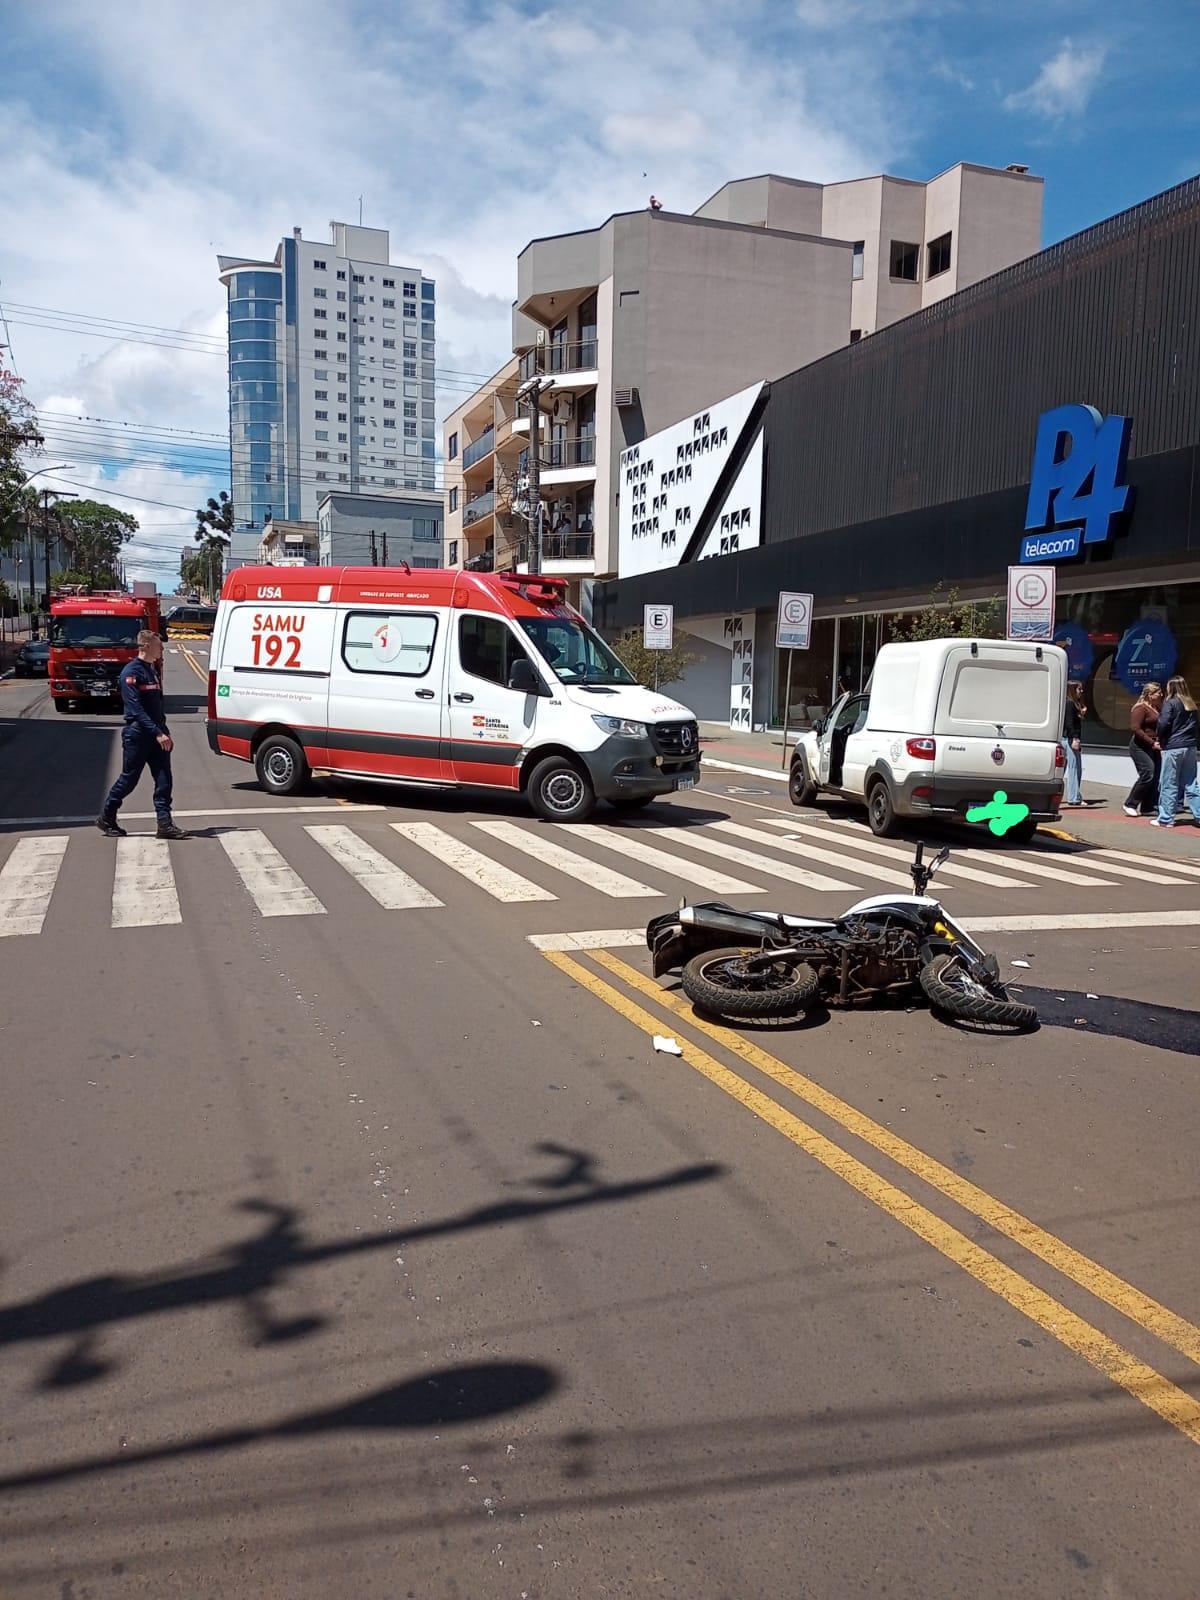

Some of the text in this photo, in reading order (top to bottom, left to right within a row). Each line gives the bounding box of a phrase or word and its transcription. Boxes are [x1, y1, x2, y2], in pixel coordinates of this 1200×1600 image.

[1025, 536, 1075, 557] telecom
[257, 586, 282, 599] USA
[1024, 580, 1039, 600] E
[654, 614, 663, 626] E
[790, 604, 800, 618] E
[252, 614, 305, 632] SAMU
[251, 634, 301, 668] 192
